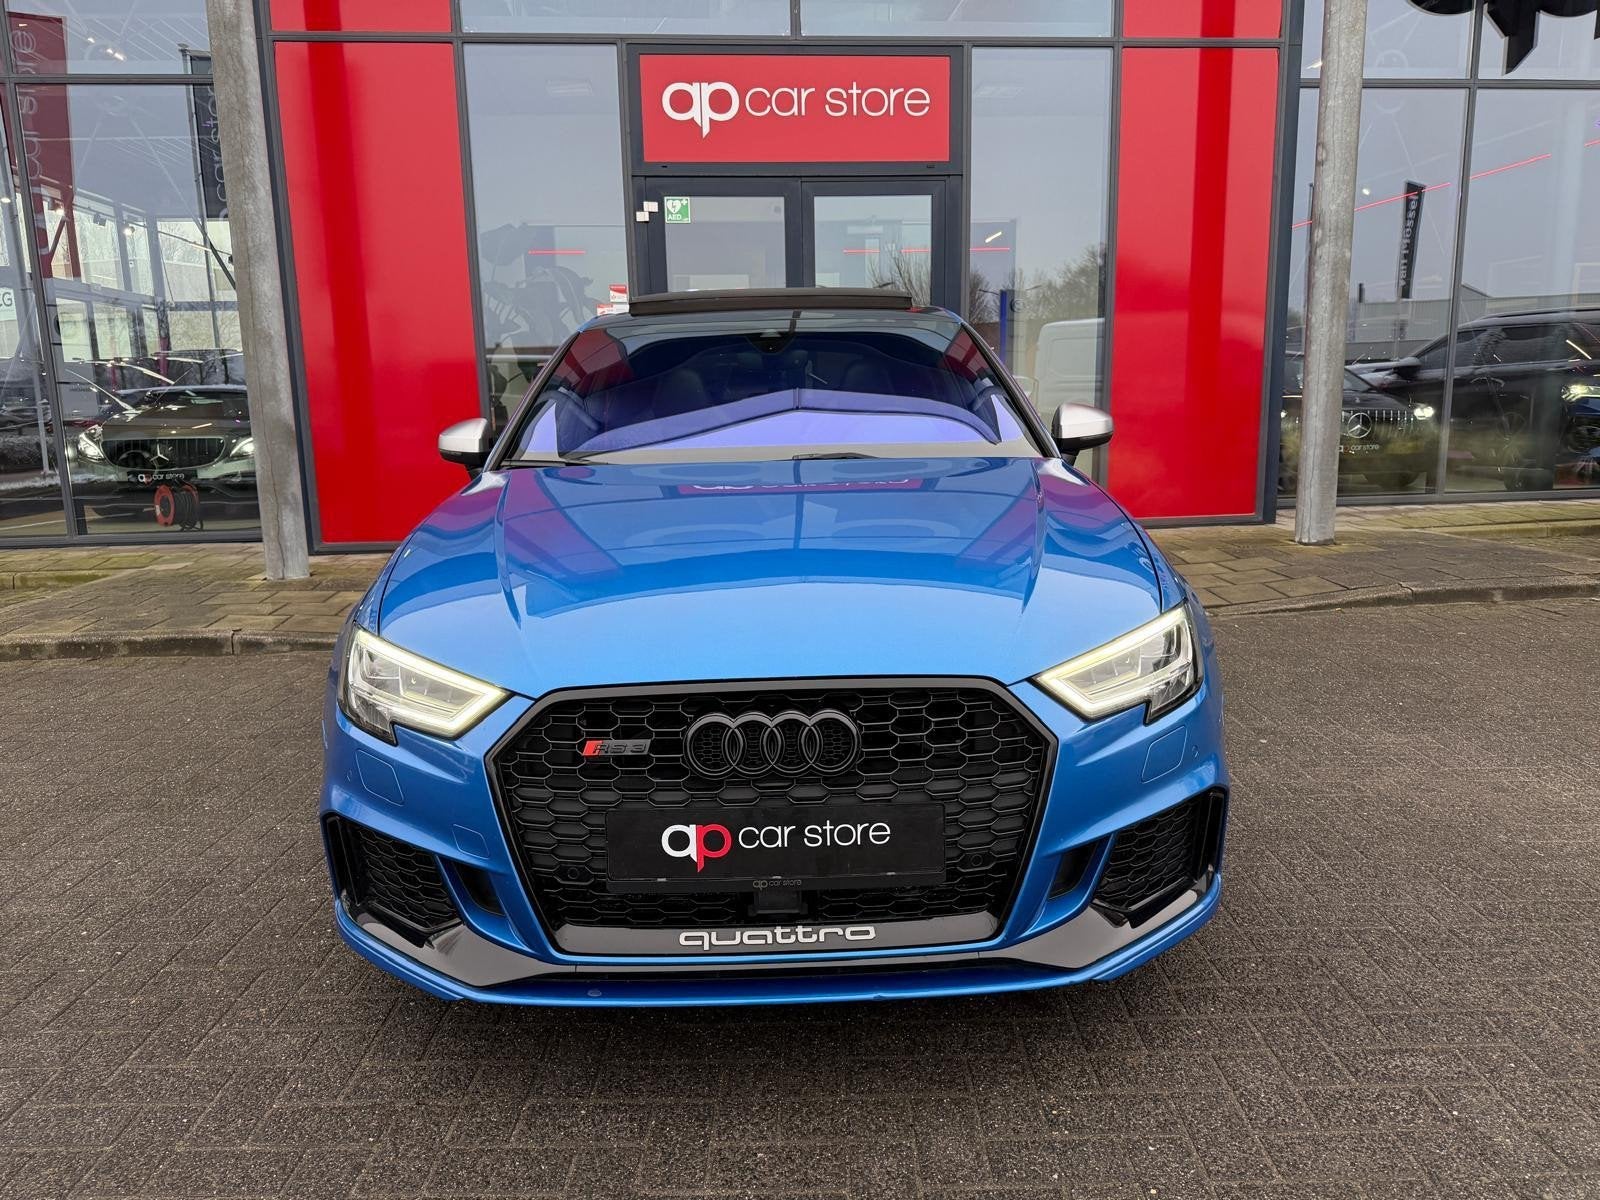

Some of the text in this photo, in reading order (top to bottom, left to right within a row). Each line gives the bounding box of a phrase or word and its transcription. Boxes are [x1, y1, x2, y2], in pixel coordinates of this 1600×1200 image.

[662, 81, 931, 139] ap car store
[667, 213, 682, 221] AED
[661, 820, 891, 873] ap car store
[679, 925, 876, 951] quattro
